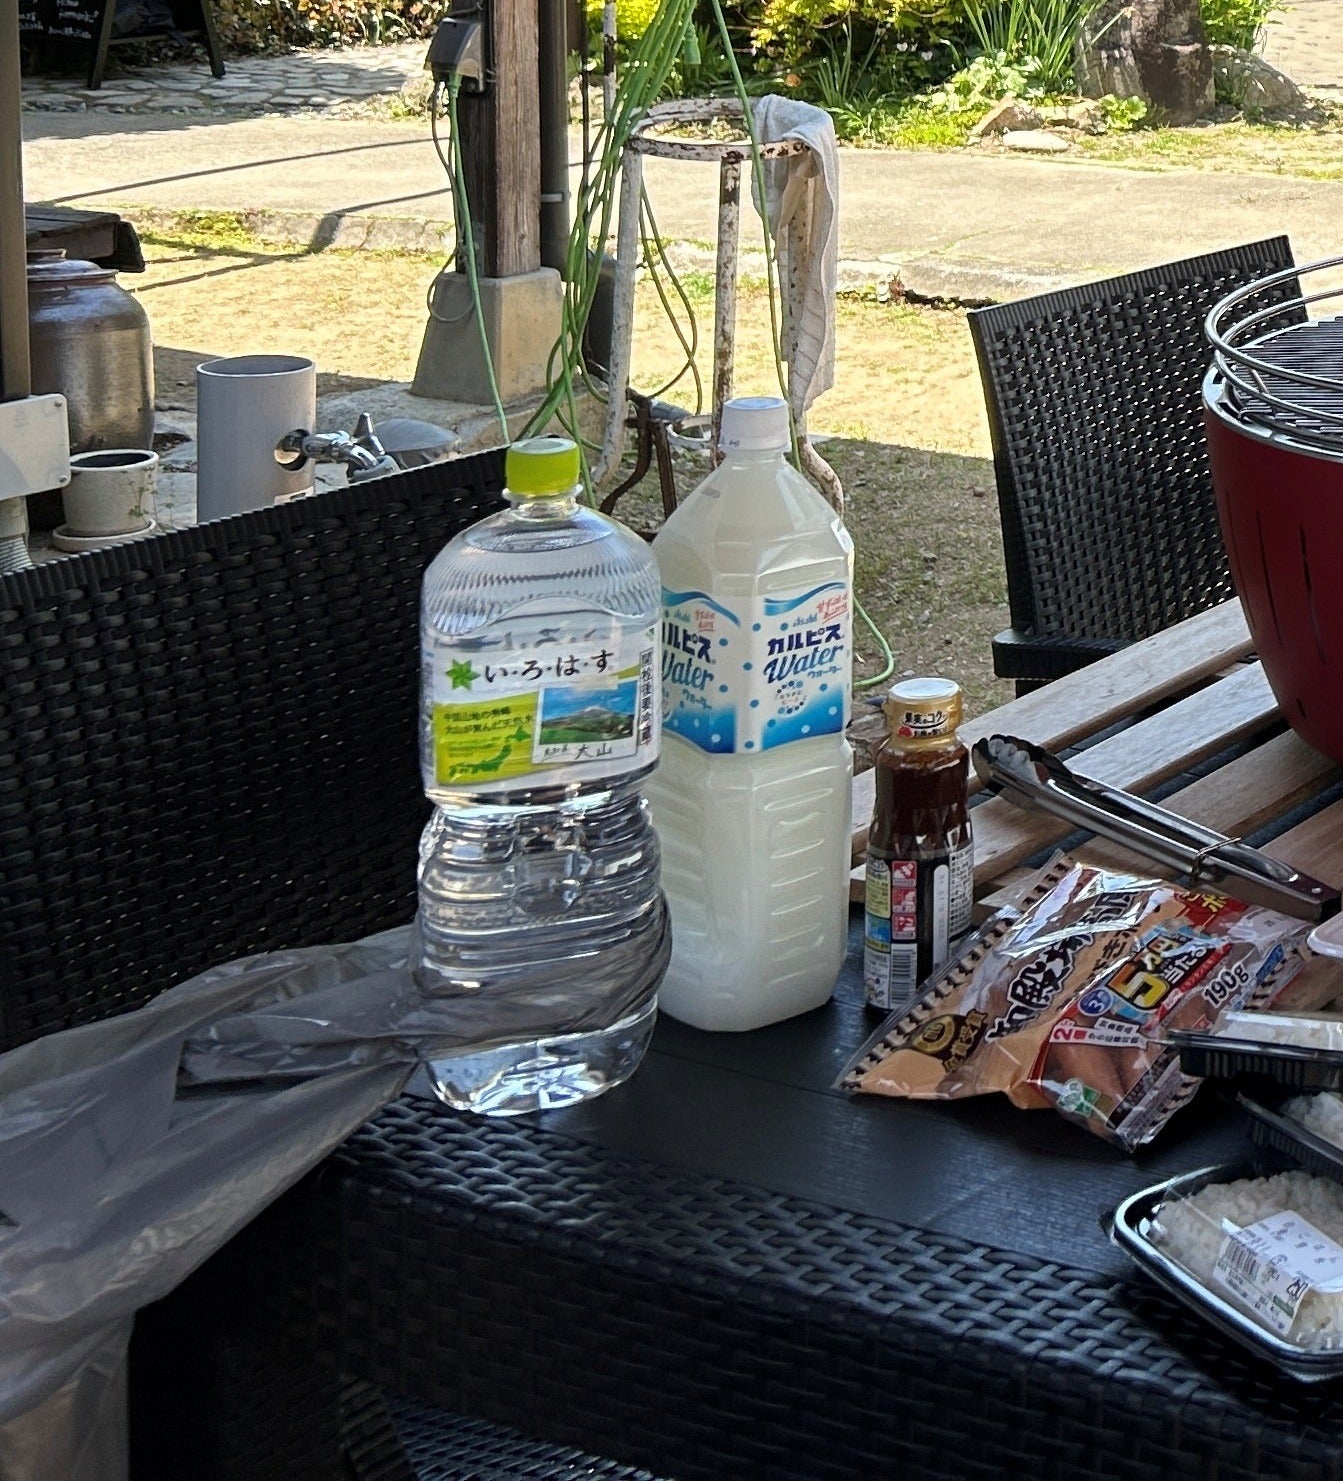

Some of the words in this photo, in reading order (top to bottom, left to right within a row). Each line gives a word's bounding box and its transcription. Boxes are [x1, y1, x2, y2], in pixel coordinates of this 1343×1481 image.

[767, 623, 843, 656] カルピス
[763, 643, 844, 684] Water
[574, 743, 613, 761] 大山
[1204, 963, 1250, 1006] 190g
